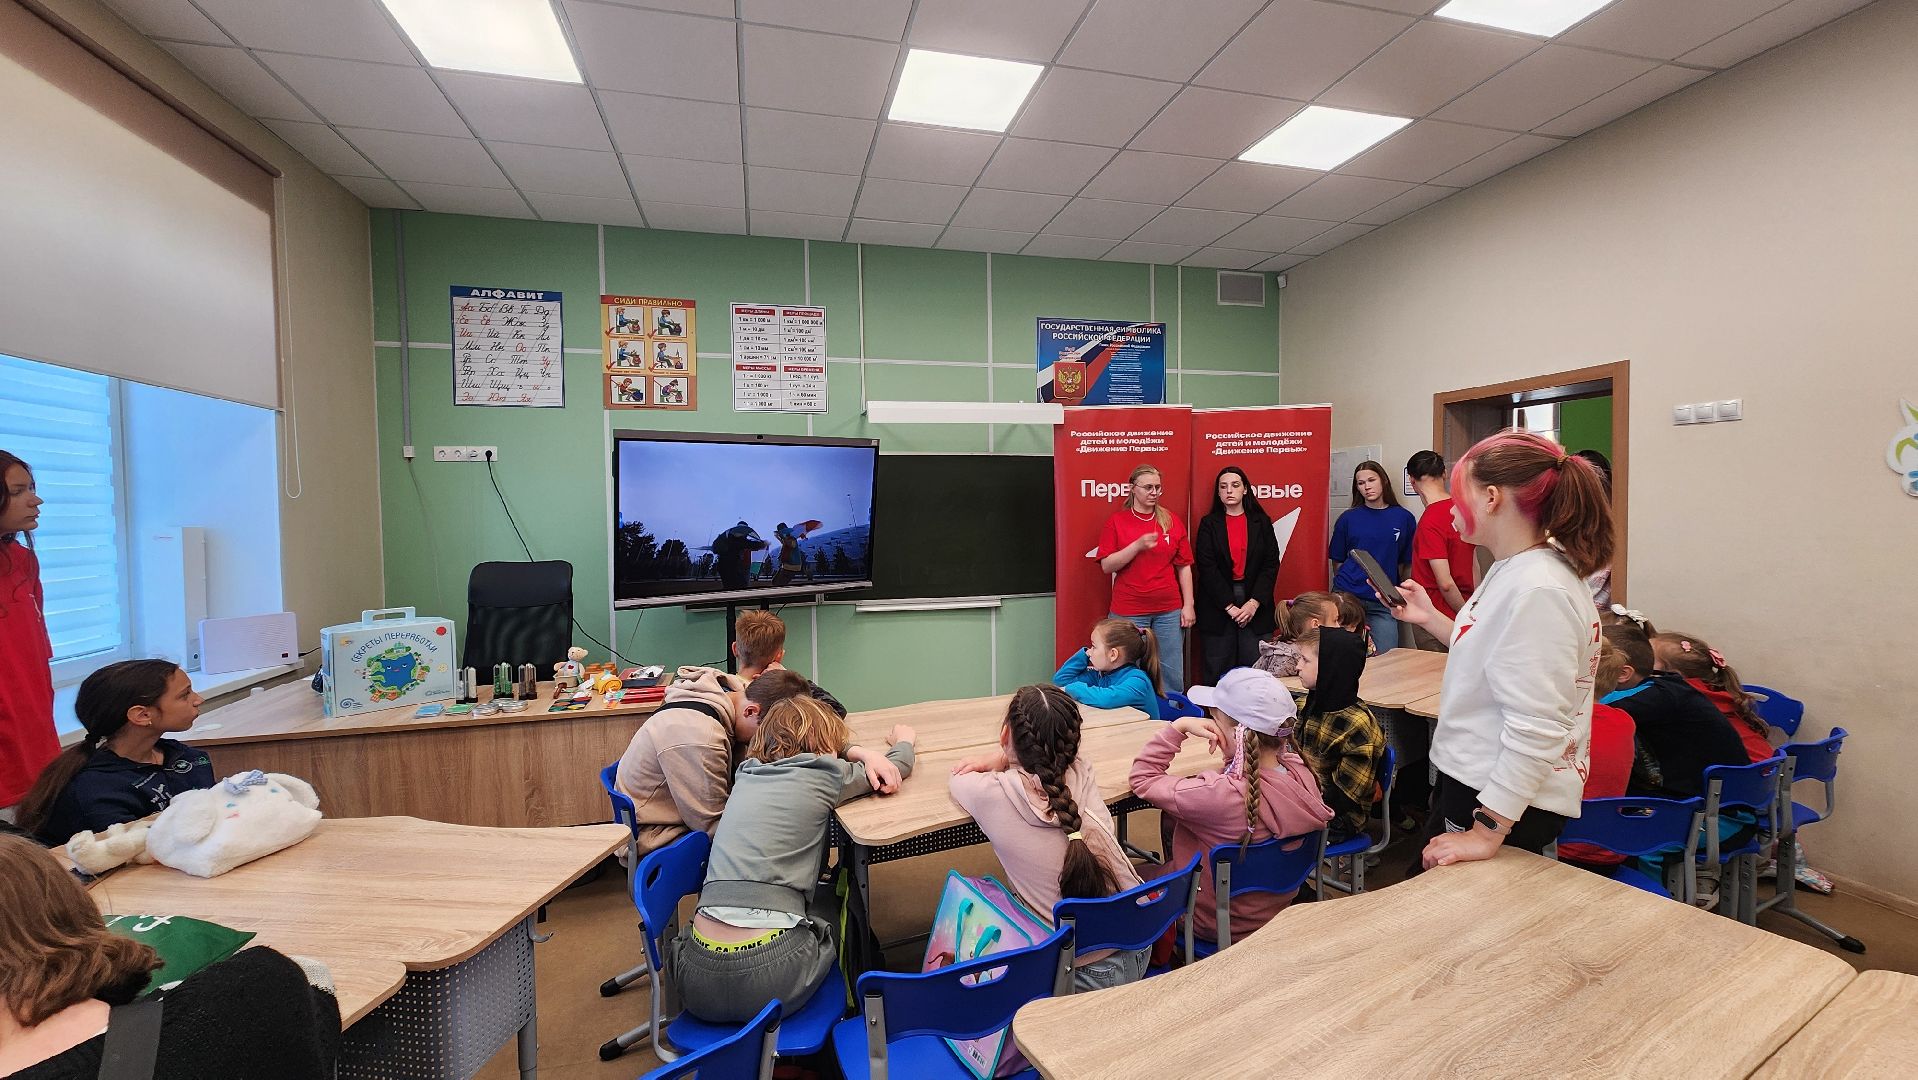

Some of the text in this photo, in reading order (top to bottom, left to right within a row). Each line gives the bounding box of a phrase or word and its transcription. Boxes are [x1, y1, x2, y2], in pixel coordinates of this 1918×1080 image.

[470, 289, 544, 300] АЛФАВИТ
[638, 298, 682, 307] ПРАВИЛЬНО
[1041, 323, 1162, 335] ГОСУДАРСТВЕННАЯ СИМВОЛИКА
[1052, 332, 1151, 343] РОССИЙСКОЙ ФЕДЕРАЦИИ
[1116, 437, 1164, 445] молодёжи
[351, 632, 438, 663] СЕКРЕТЫ ПЕРЕРАБОТКИ
